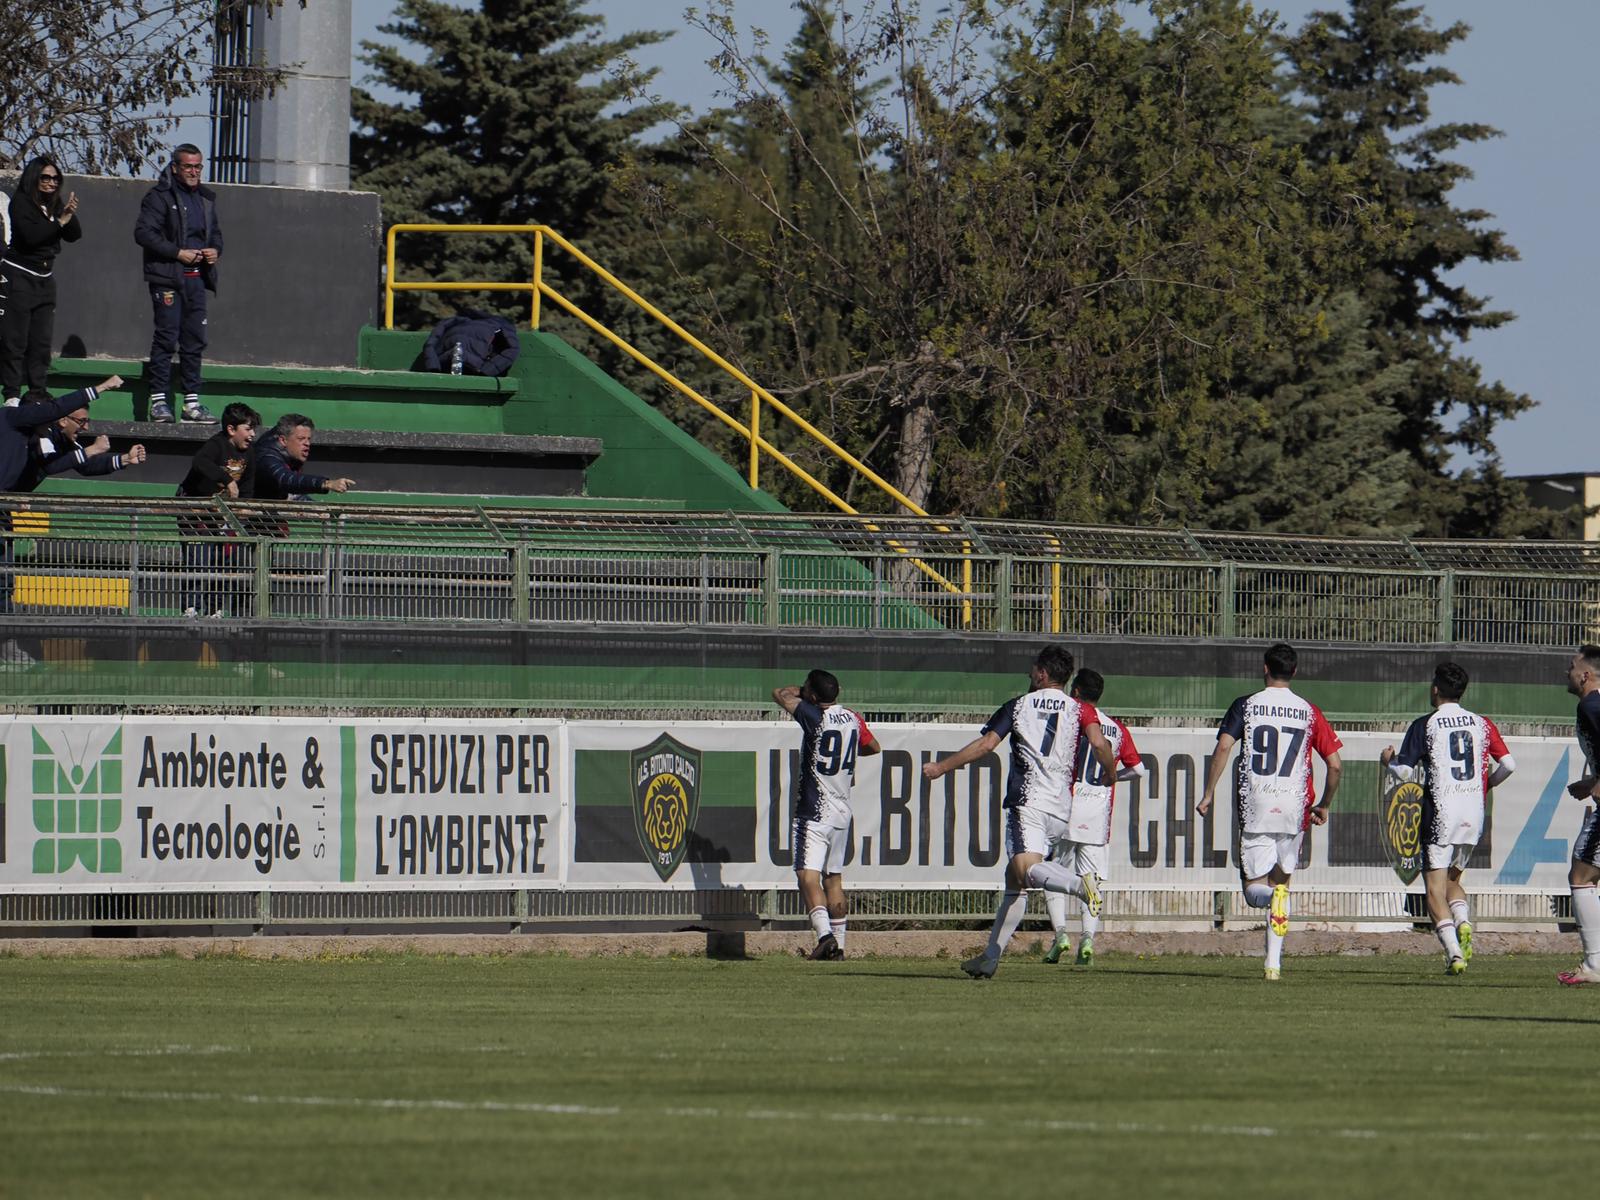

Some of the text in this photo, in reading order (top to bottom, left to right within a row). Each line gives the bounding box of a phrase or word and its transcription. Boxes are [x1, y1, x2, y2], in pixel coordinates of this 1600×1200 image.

[1032, 698, 1066, 712] VACCA
[1252, 705, 1308, 721] COLACICCHI
[1437, 715, 1476, 729] FELLECA
[816, 729, 858, 776] 94
[1036, 711, 1060, 757] 7
[1251, 724, 1307, 778] 97
[1449, 730, 1476, 781] 9
[138, 732, 326, 790] Ambiente &
[371, 733, 550, 794] SERVIZI PER
[658, 851, 672, 864] 1921
[1400, 856, 1416, 869] 1921
